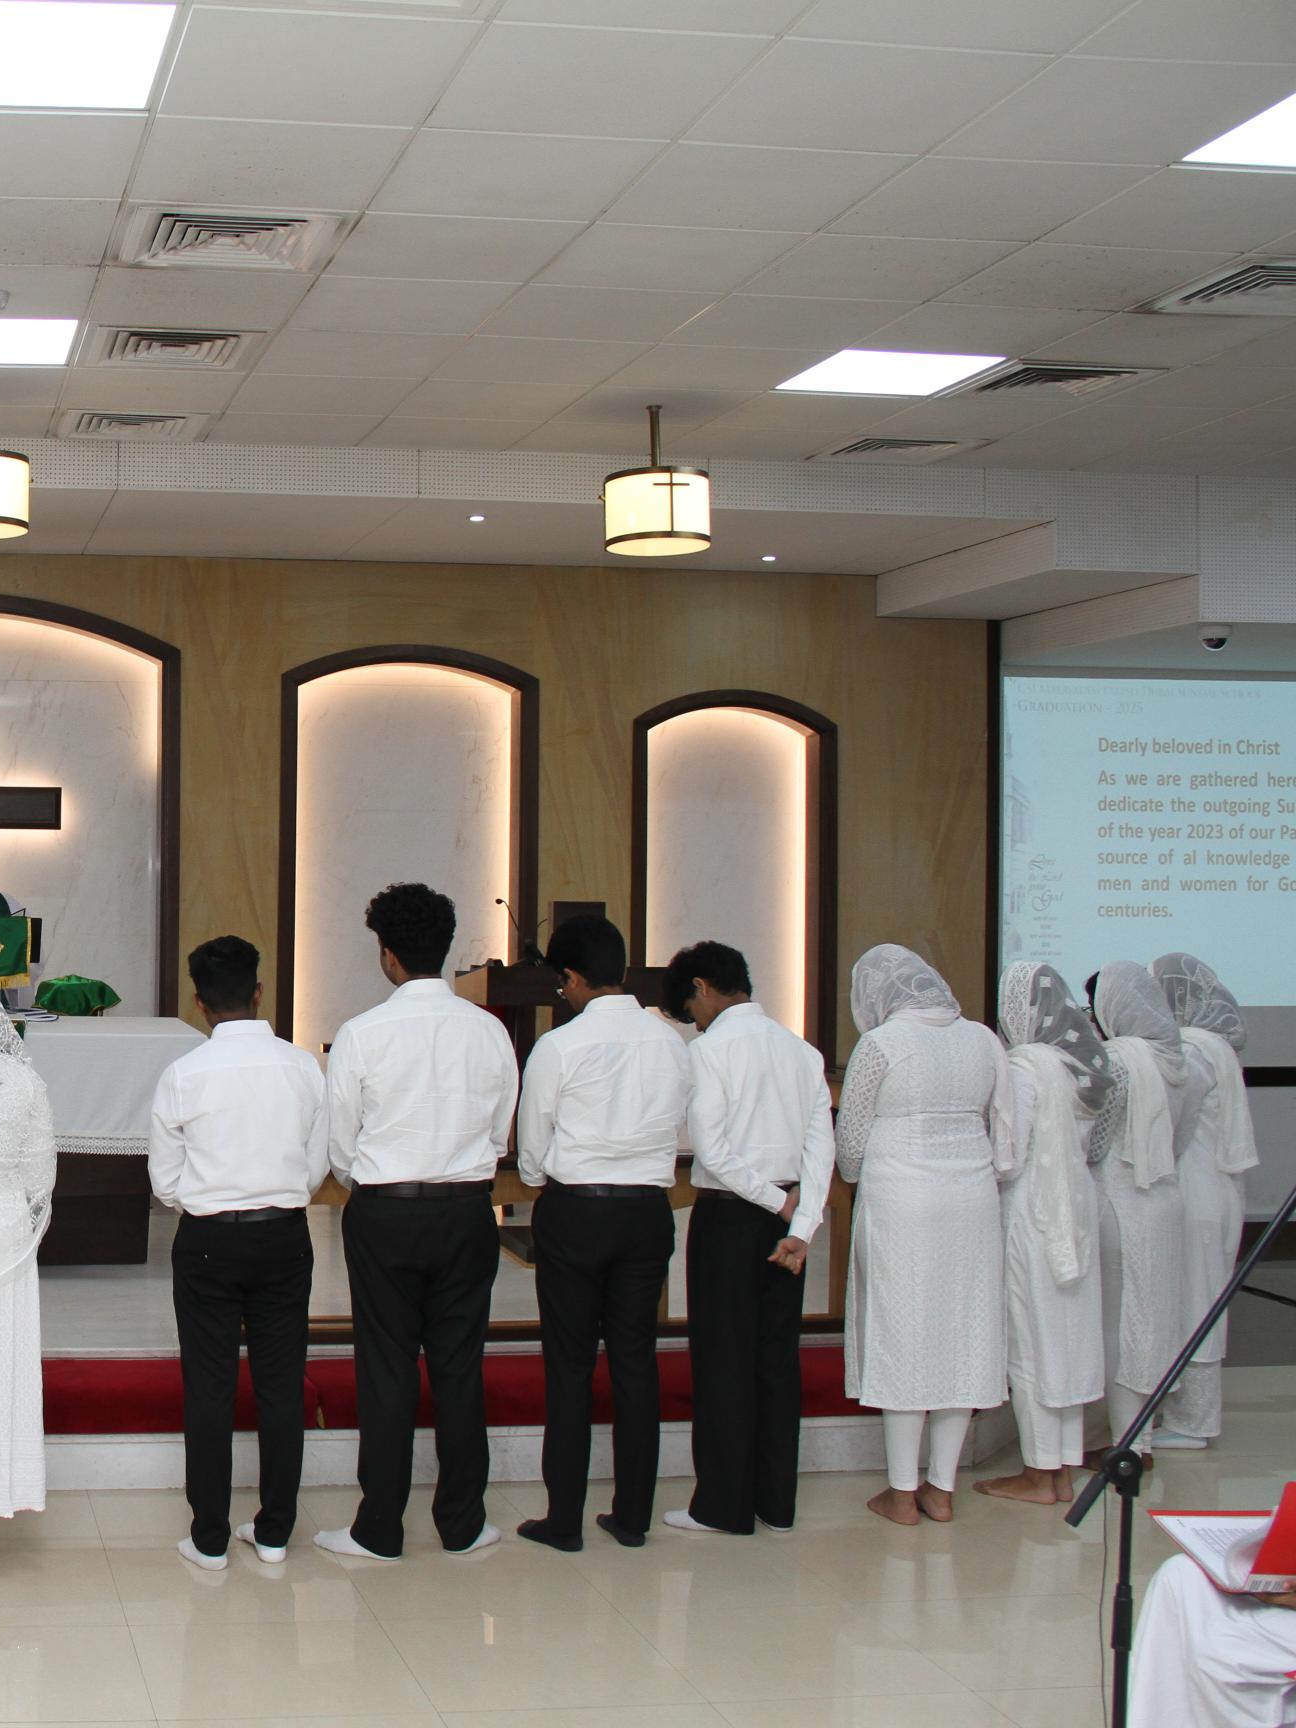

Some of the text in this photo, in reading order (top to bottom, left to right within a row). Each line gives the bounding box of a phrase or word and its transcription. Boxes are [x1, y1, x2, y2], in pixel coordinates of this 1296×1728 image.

[1098, 737, 1281, 756] Dearly beloved in Christ
[1098, 770, 1296, 790] As we are gathered here
[1098, 796, 1164, 812] dedicate
[1171, 797, 1196, 812] the
[1203, 798, 1270, 816] outgoing
[1098, 823, 1114, 838] of
[1119, 823, 1143, 838] the
[1148, 826, 1182, 841] year
[1187, 824, 1223, 839] 2023
[1228, 824, 1245, 839] of
[1249, 827, 1275, 840] our
[1097, 849, 1290, 869] source of al knowledge
[1097, 878, 1132, 892] men
[1141, 876, 1170, 891] and
[1180, 879, 1237, 892] women
[1246, 875, 1269, 891] for
[1097, 902, 1173, 917] centuries.
